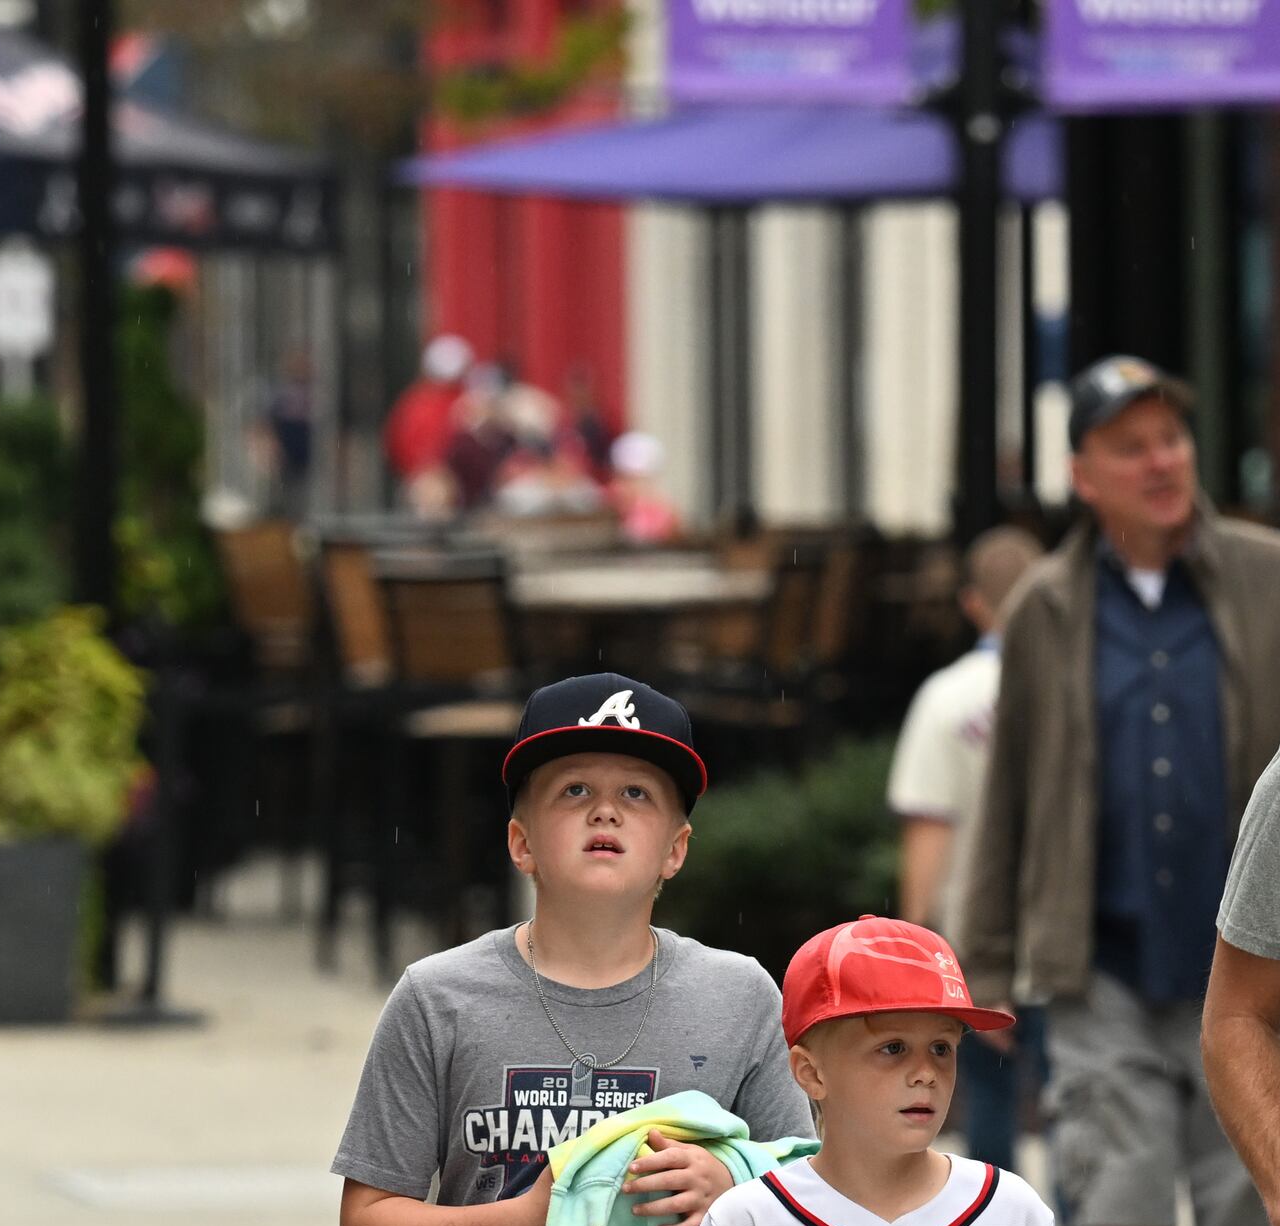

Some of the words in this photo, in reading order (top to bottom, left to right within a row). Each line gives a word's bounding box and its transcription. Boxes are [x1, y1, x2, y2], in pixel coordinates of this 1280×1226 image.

[578, 689, 640, 730] A
[543, 1077, 567, 1088] 20
[597, 1079, 619, 1089] 21
[514, 1090, 567, 1106] WORLD
[595, 1092, 647, 1108] SERIES
